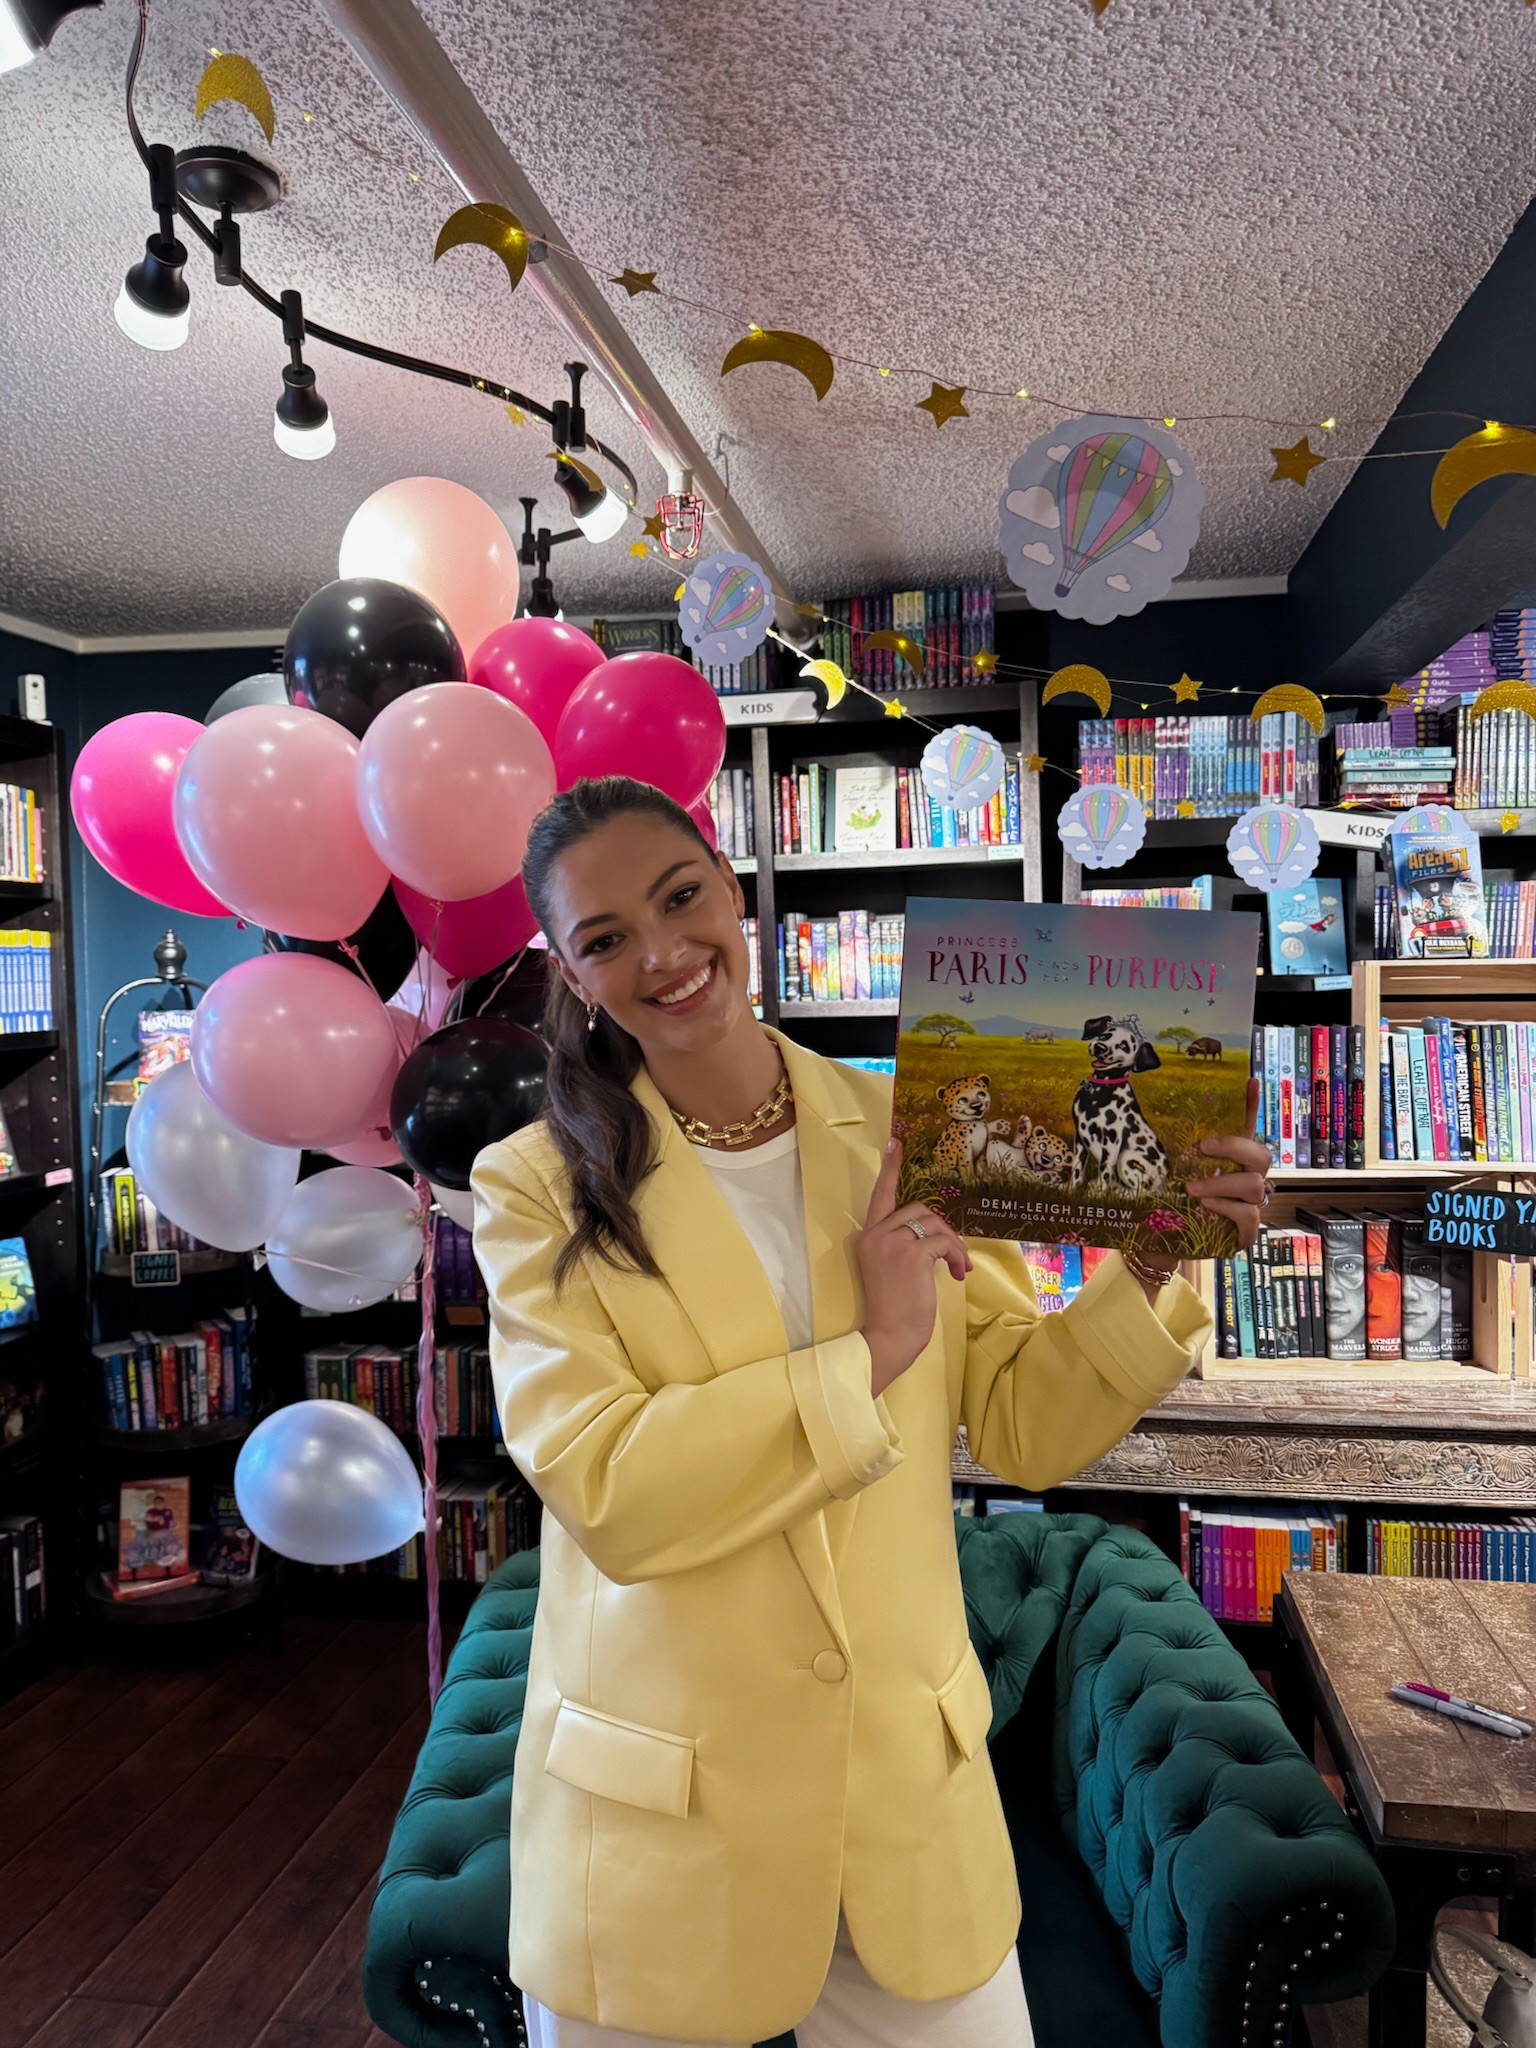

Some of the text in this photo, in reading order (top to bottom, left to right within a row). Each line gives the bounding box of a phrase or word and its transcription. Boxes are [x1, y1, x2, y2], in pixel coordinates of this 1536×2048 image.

[740, 703, 774, 714] KIDS
[1346, 824, 1386, 838] KIDS
[1446, 847, 1471, 873] 51
[926, 950, 1029, 985] PARIS
[1413, 1059, 1425, 1085] LEAH
[1397, 1074, 1410, 1113] THE BRAVE
[1454, 1053, 1472, 1138] AMERICAN STREET
[966, 1207, 1140, 1230] Illustrated by OLGA & ALEKSEY IVANOV
[981, 1197, 1133, 1220] DEMI-LEIGH TEBOW
[1427, 1191, 1506, 1221] SIGNED
[1428, 1219, 1497, 1249] BOOKS
[1224, 1265, 1234, 1327] GIRL ROBOT
[1331, 1343, 1366, 1351] MARVELS
[1368, 1337, 1401, 1345] WONDER
[1446, 1337, 1469, 1345] HUGO
